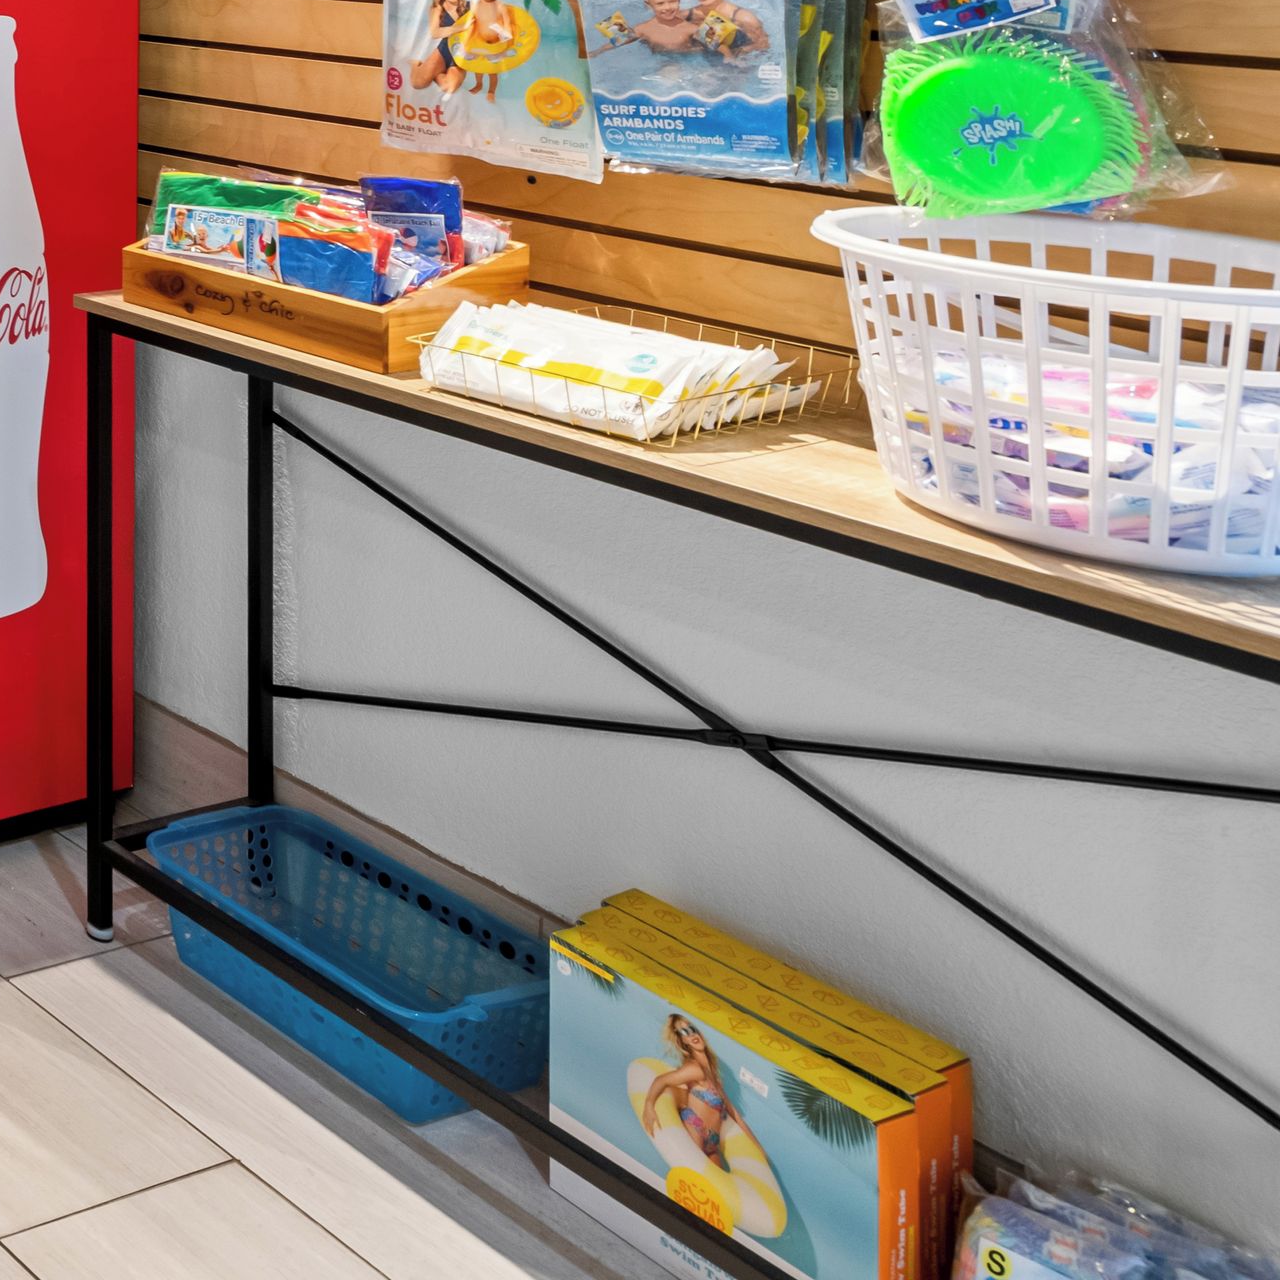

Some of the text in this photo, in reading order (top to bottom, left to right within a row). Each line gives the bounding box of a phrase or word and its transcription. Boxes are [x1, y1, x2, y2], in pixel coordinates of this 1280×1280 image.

[385, 93, 447, 127] Float
[600, 104, 708, 118] SURF BUDDIES
[396, 123, 415, 133] BABY
[603, 117, 685, 130] ARMBANDS
[625, 130, 645, 141] One
[645, 131, 662, 142] Pair
[663, 131, 676, 142] Of
[677, 133, 725, 145] Armbands
[962, 118, 1021, 145] SPLASH!
[540, 136, 589, 149] One Float
[208, 213, 235, 226] Beach
[580, 407, 602, 417] NOT
[985, 1247, 1007, 1277] S
